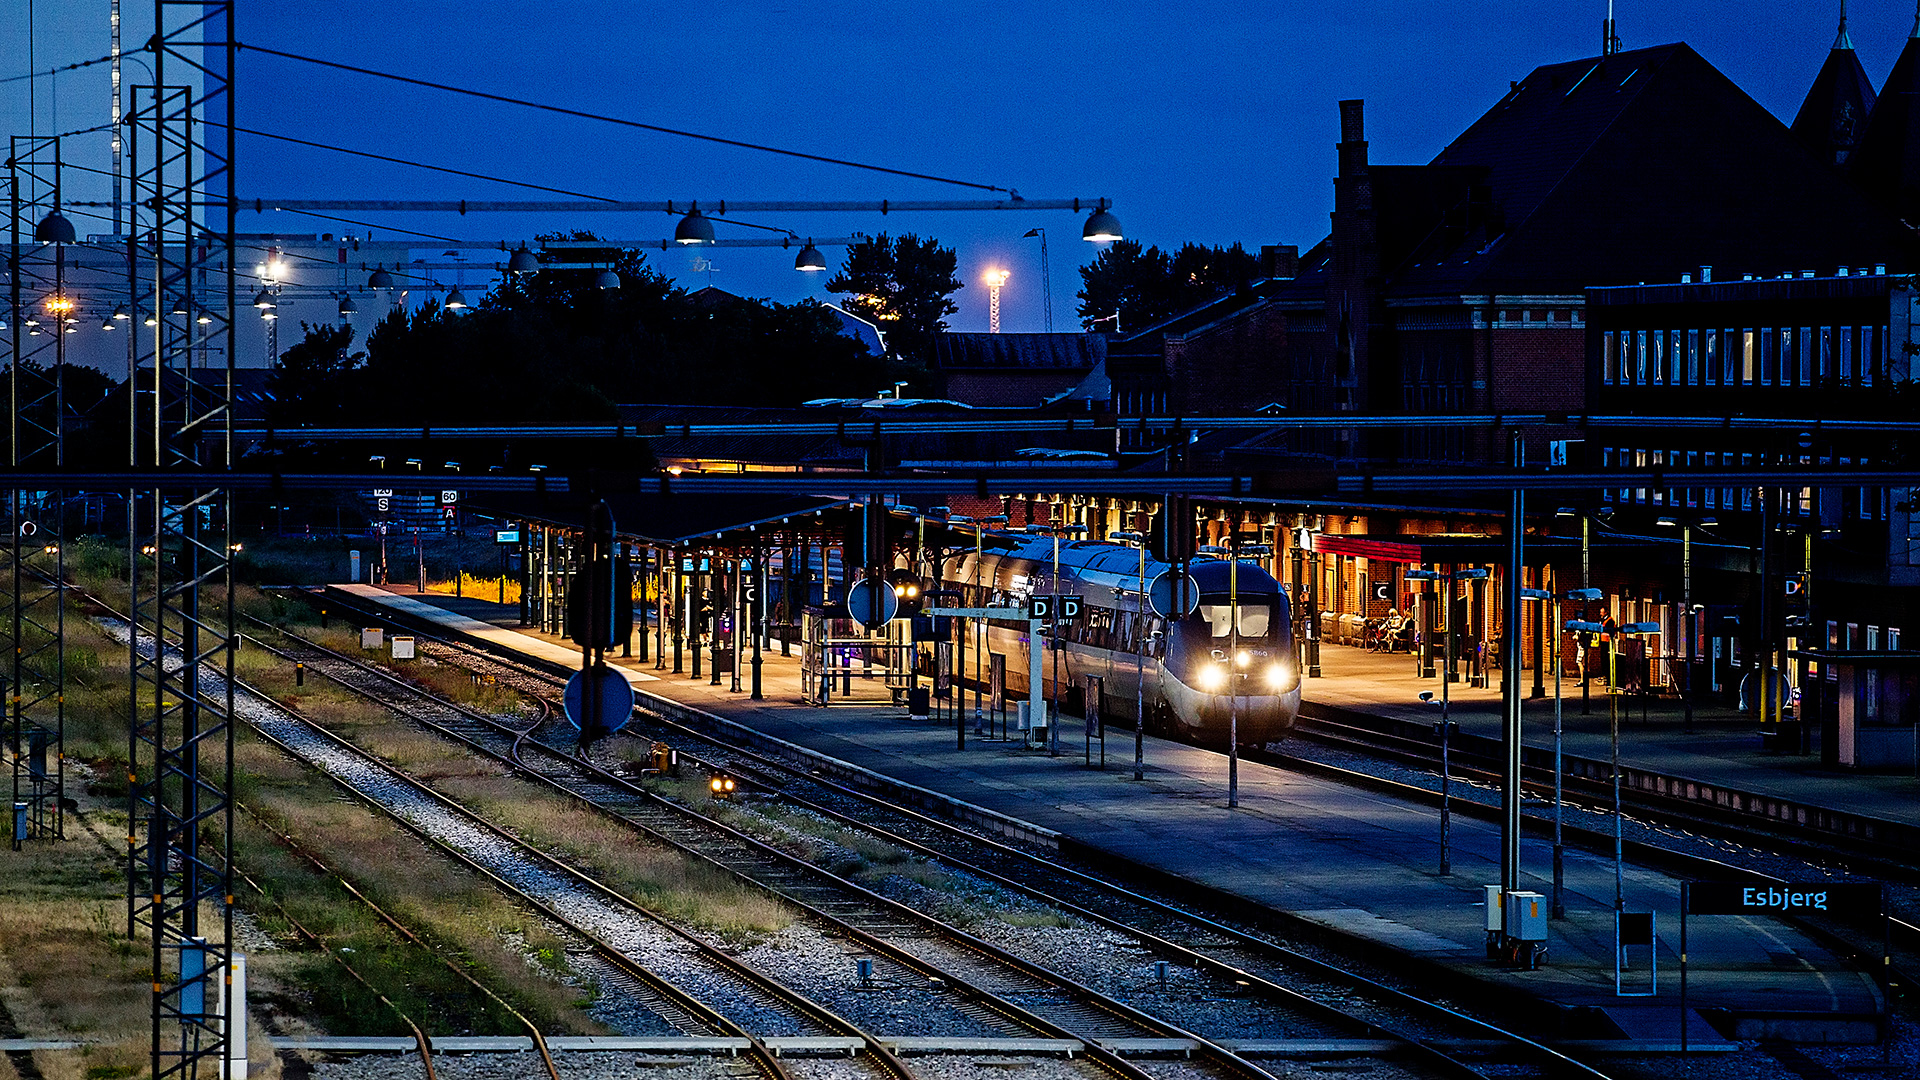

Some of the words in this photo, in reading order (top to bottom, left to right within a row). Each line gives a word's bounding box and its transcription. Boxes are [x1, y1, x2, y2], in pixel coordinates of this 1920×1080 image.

[443, 492, 456, 501] 60
[379, 499, 388, 510] S
[445, 508, 454, 518] A
[1377, 585, 1388, 599] C
[1785, 580, 1799, 595] D
[745, 588, 755, 602] C
[1034, 601, 1047, 616] D
[1065, 601, 1079, 616] D
[1743, 886, 1828, 911] Esbjerg
